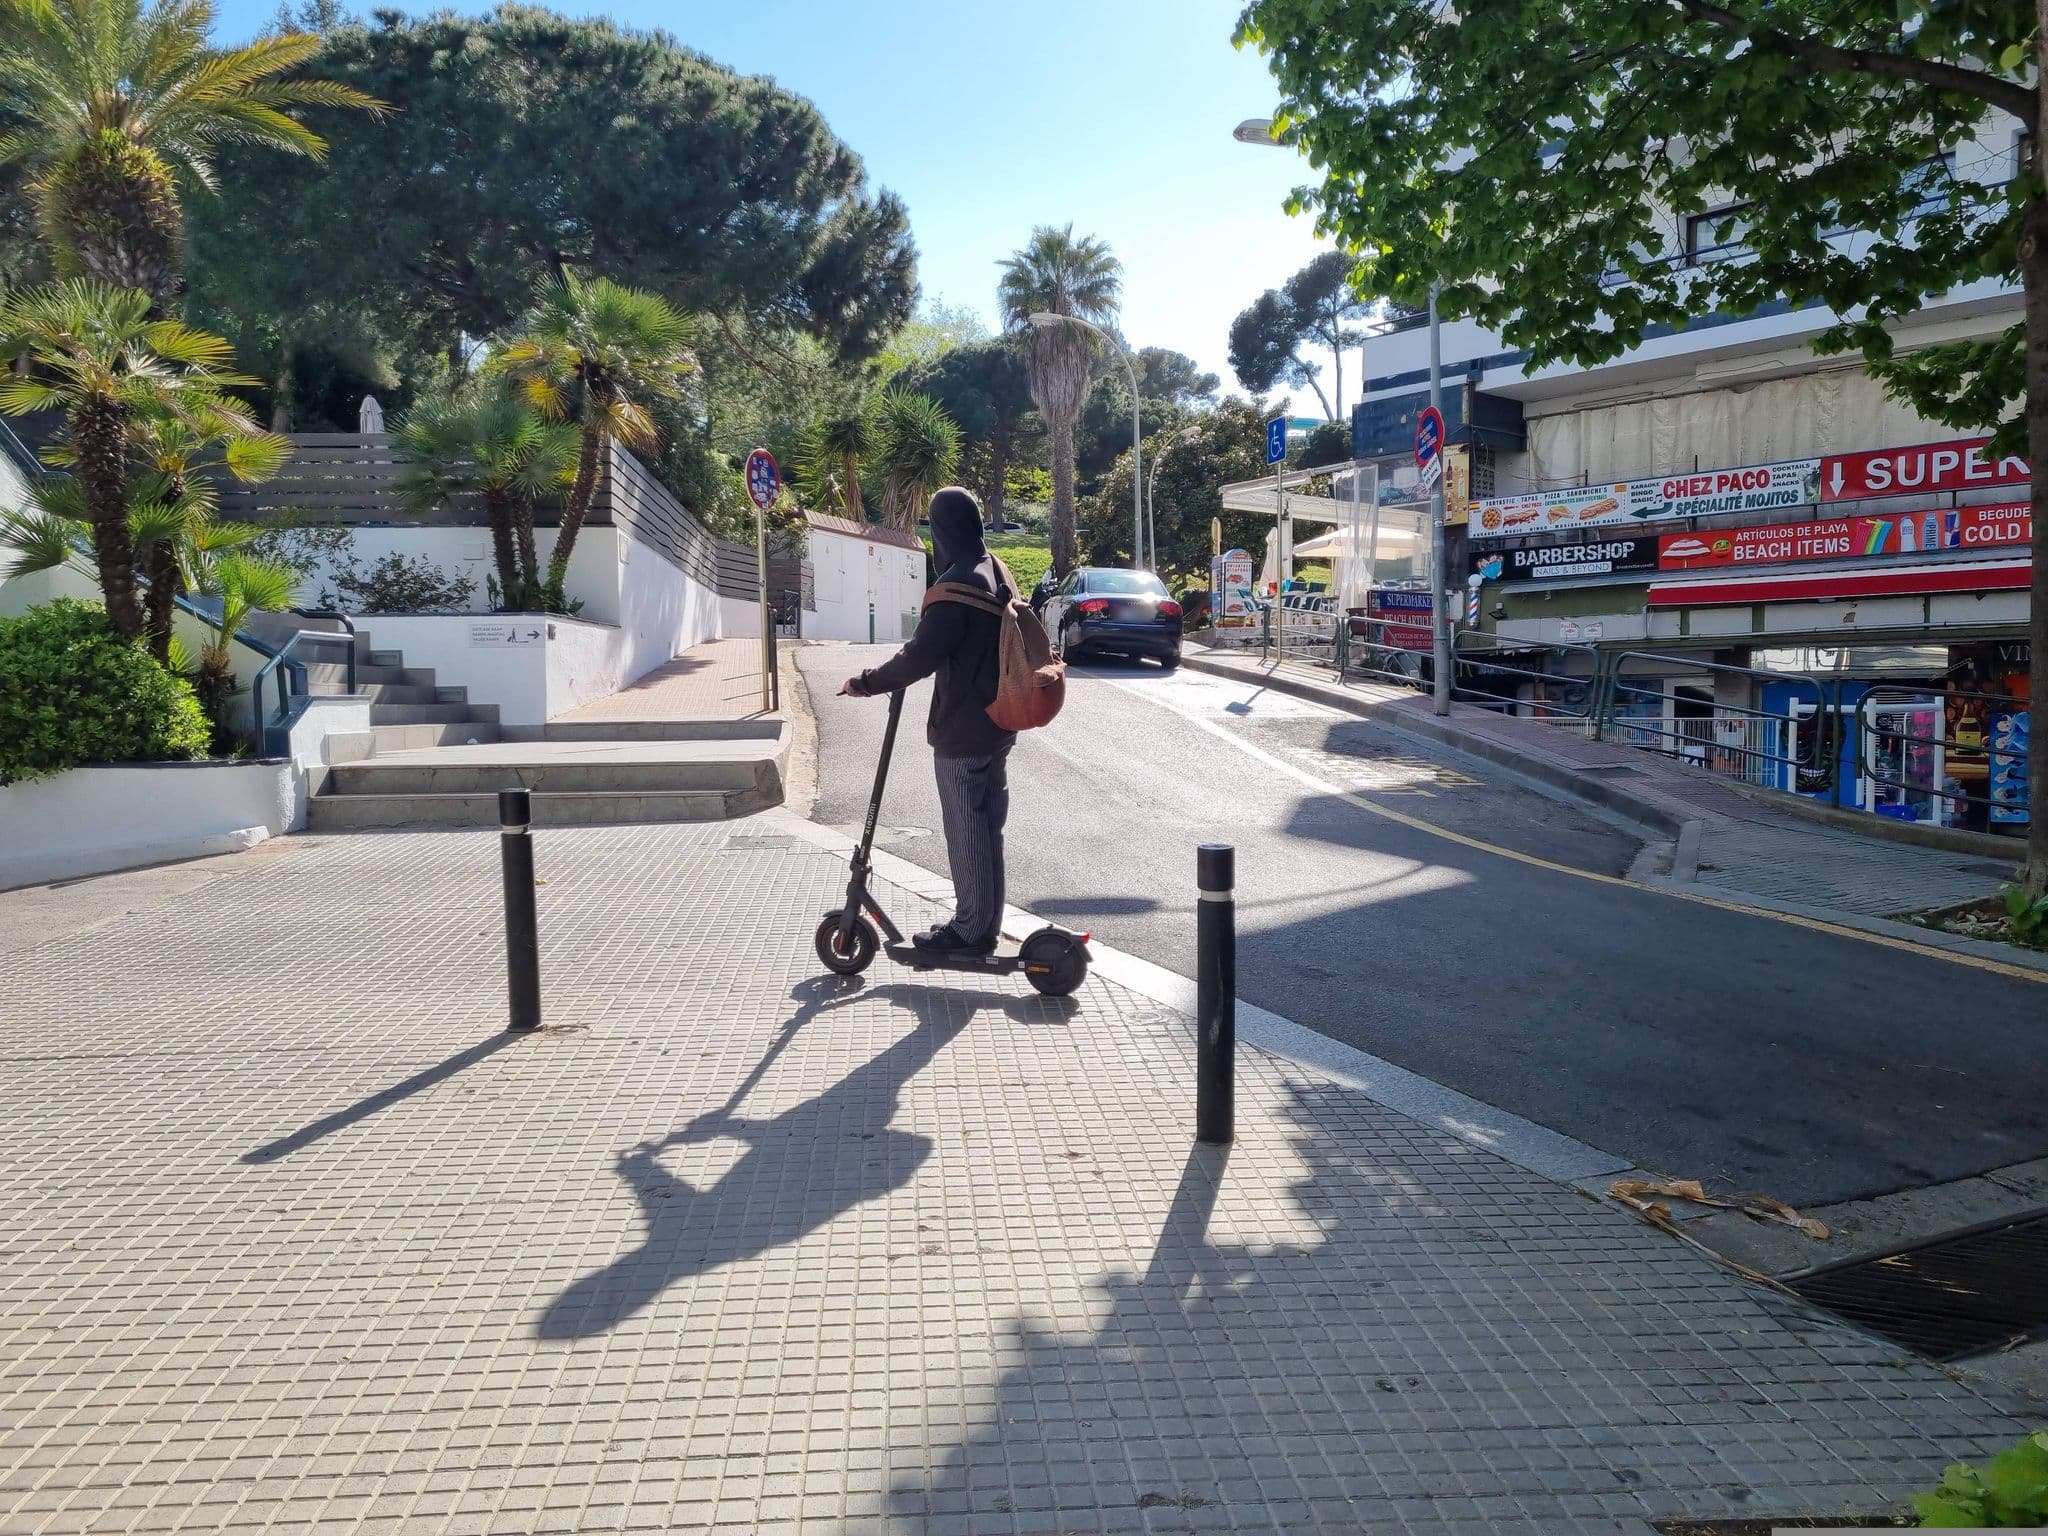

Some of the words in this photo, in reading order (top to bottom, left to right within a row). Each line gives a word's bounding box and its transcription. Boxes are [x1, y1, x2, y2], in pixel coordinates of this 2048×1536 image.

[1772, 463, 1811, 473] COCKTAILS
[1865, 446, 2031, 490] SUPER
[1772, 472, 1797, 480] TAPAS
[1630, 482, 1661, 490] KARAOKE
[1662, 476, 1713, 499] CHEZ
[1717, 469, 1771, 493] PACO
[1772, 480, 1800, 488] SNACKS
[1544, 492, 1561, 500] PIZZA
[1630, 489, 1654, 497] BINGO
[1630, 496, 1654, 504] MAGIC
[1675, 492, 1743, 516] SPÉCIALITÉ
[1745, 489, 1799, 508] MOJITOS
[1736, 528, 1794, 542] ARTÍCULOS
[1797, 526, 1811, 537] DE
[1814, 523, 1848, 534] PLAYA
[1965, 523, 2021, 543] COLD
[1515, 541, 1635, 567] BARBERSHOP
[1733, 543, 1792, 561] BEACH
[1797, 537, 1850, 556] ITEMS
[1535, 565, 1559, 577] NAILS
[1562, 565, 1570, 575] &
[1572, 563, 1610, 574] BEYOND
